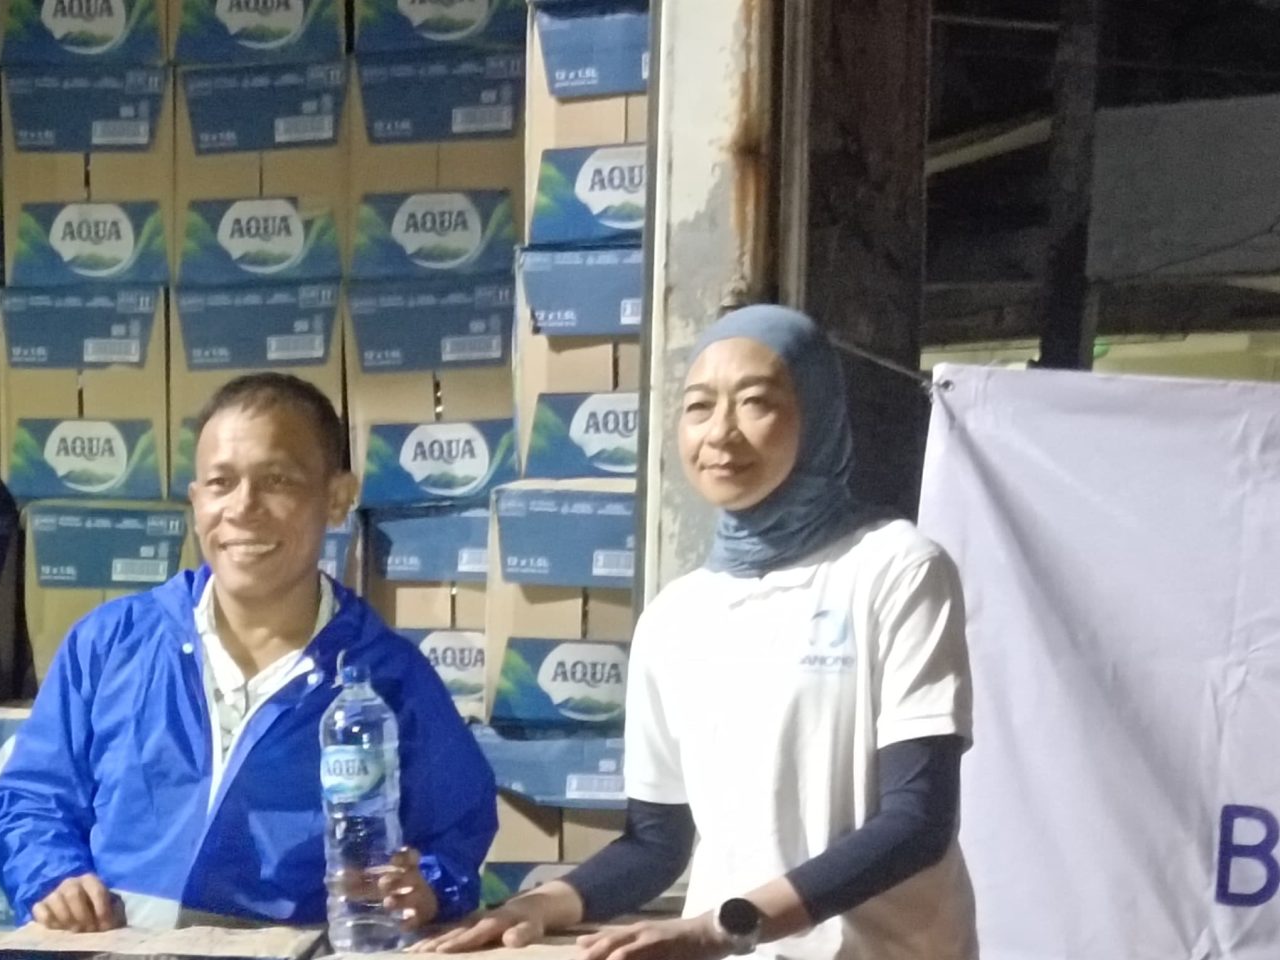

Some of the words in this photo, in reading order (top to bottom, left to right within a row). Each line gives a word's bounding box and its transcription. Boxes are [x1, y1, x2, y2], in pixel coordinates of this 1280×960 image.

[52, 0, 114, 21] AQUA
[588, 165, 643, 193] AQU
[61, 219, 122, 244] AQUA
[229, 216, 293, 241] AQUA
[404, 210, 469, 236] AQUA
[584, 411, 637, 437] AQU
[56, 436, 116, 461] AQUA
[412, 438, 476, 463] AQUA
[551, 661, 623, 688] AQUA
